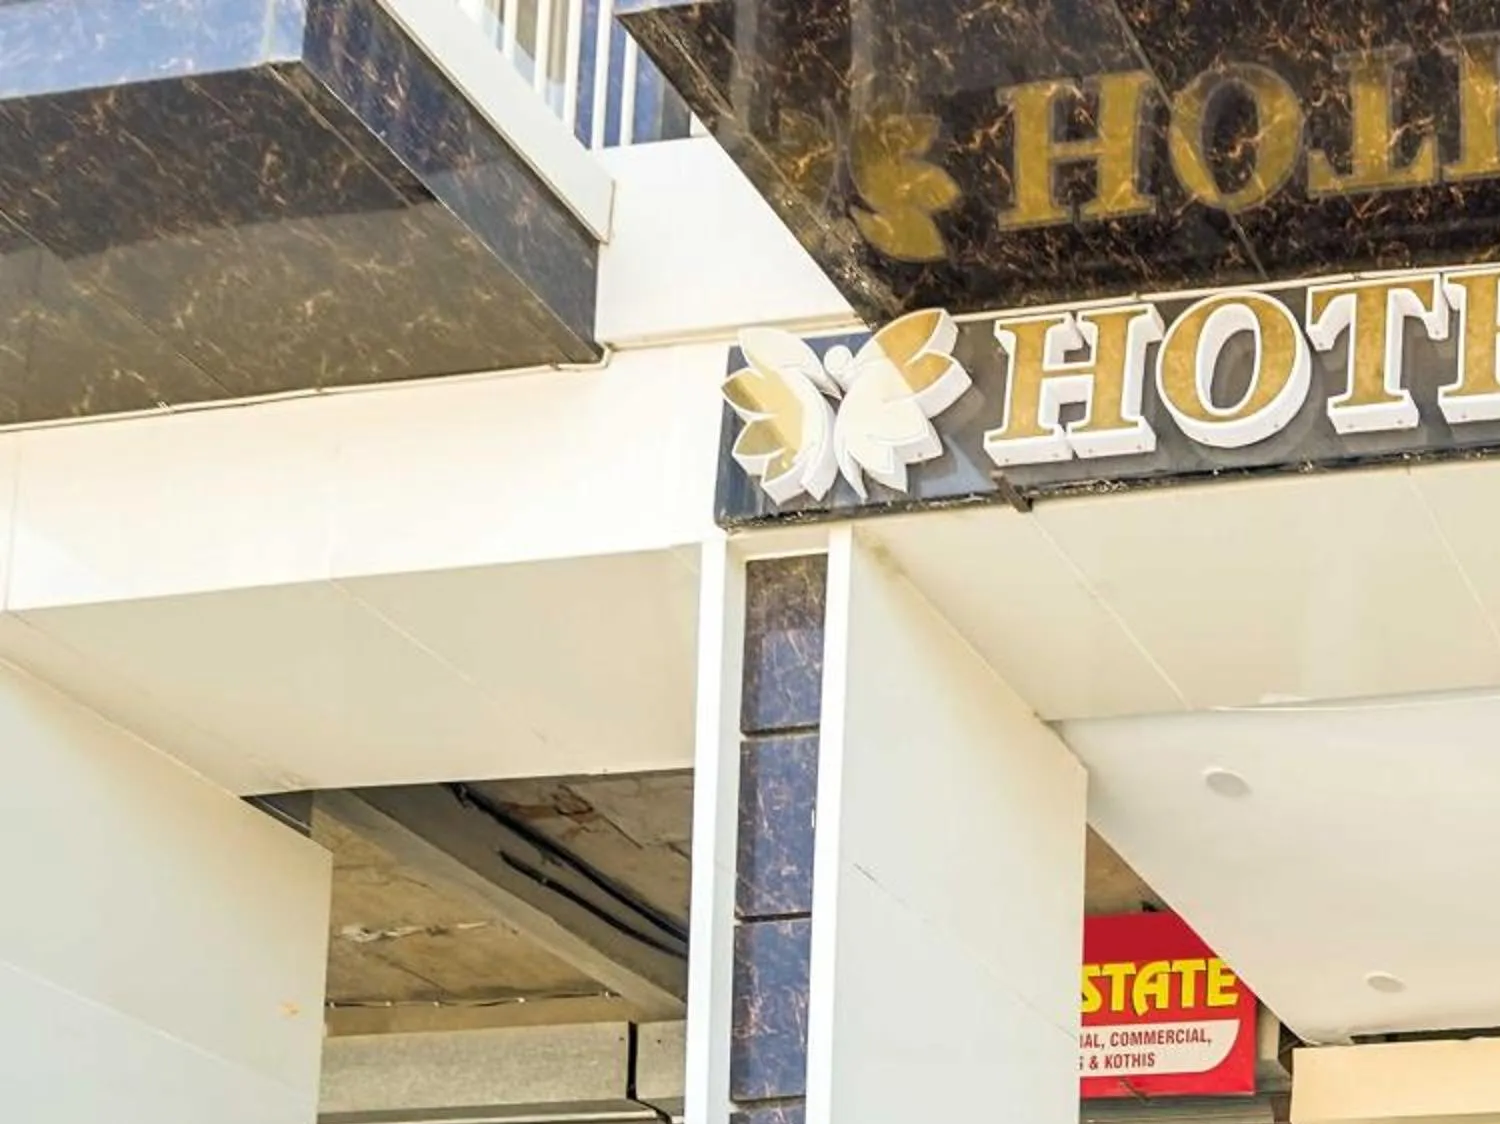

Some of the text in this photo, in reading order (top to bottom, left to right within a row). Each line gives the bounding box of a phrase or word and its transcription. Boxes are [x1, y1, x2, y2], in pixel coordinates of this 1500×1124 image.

[1110, 1028, 1212, 1048] COMMERCIAL,
[1089, 1056, 1099, 1070] &
[1104, 1052, 1155, 1070] KOTHIS
